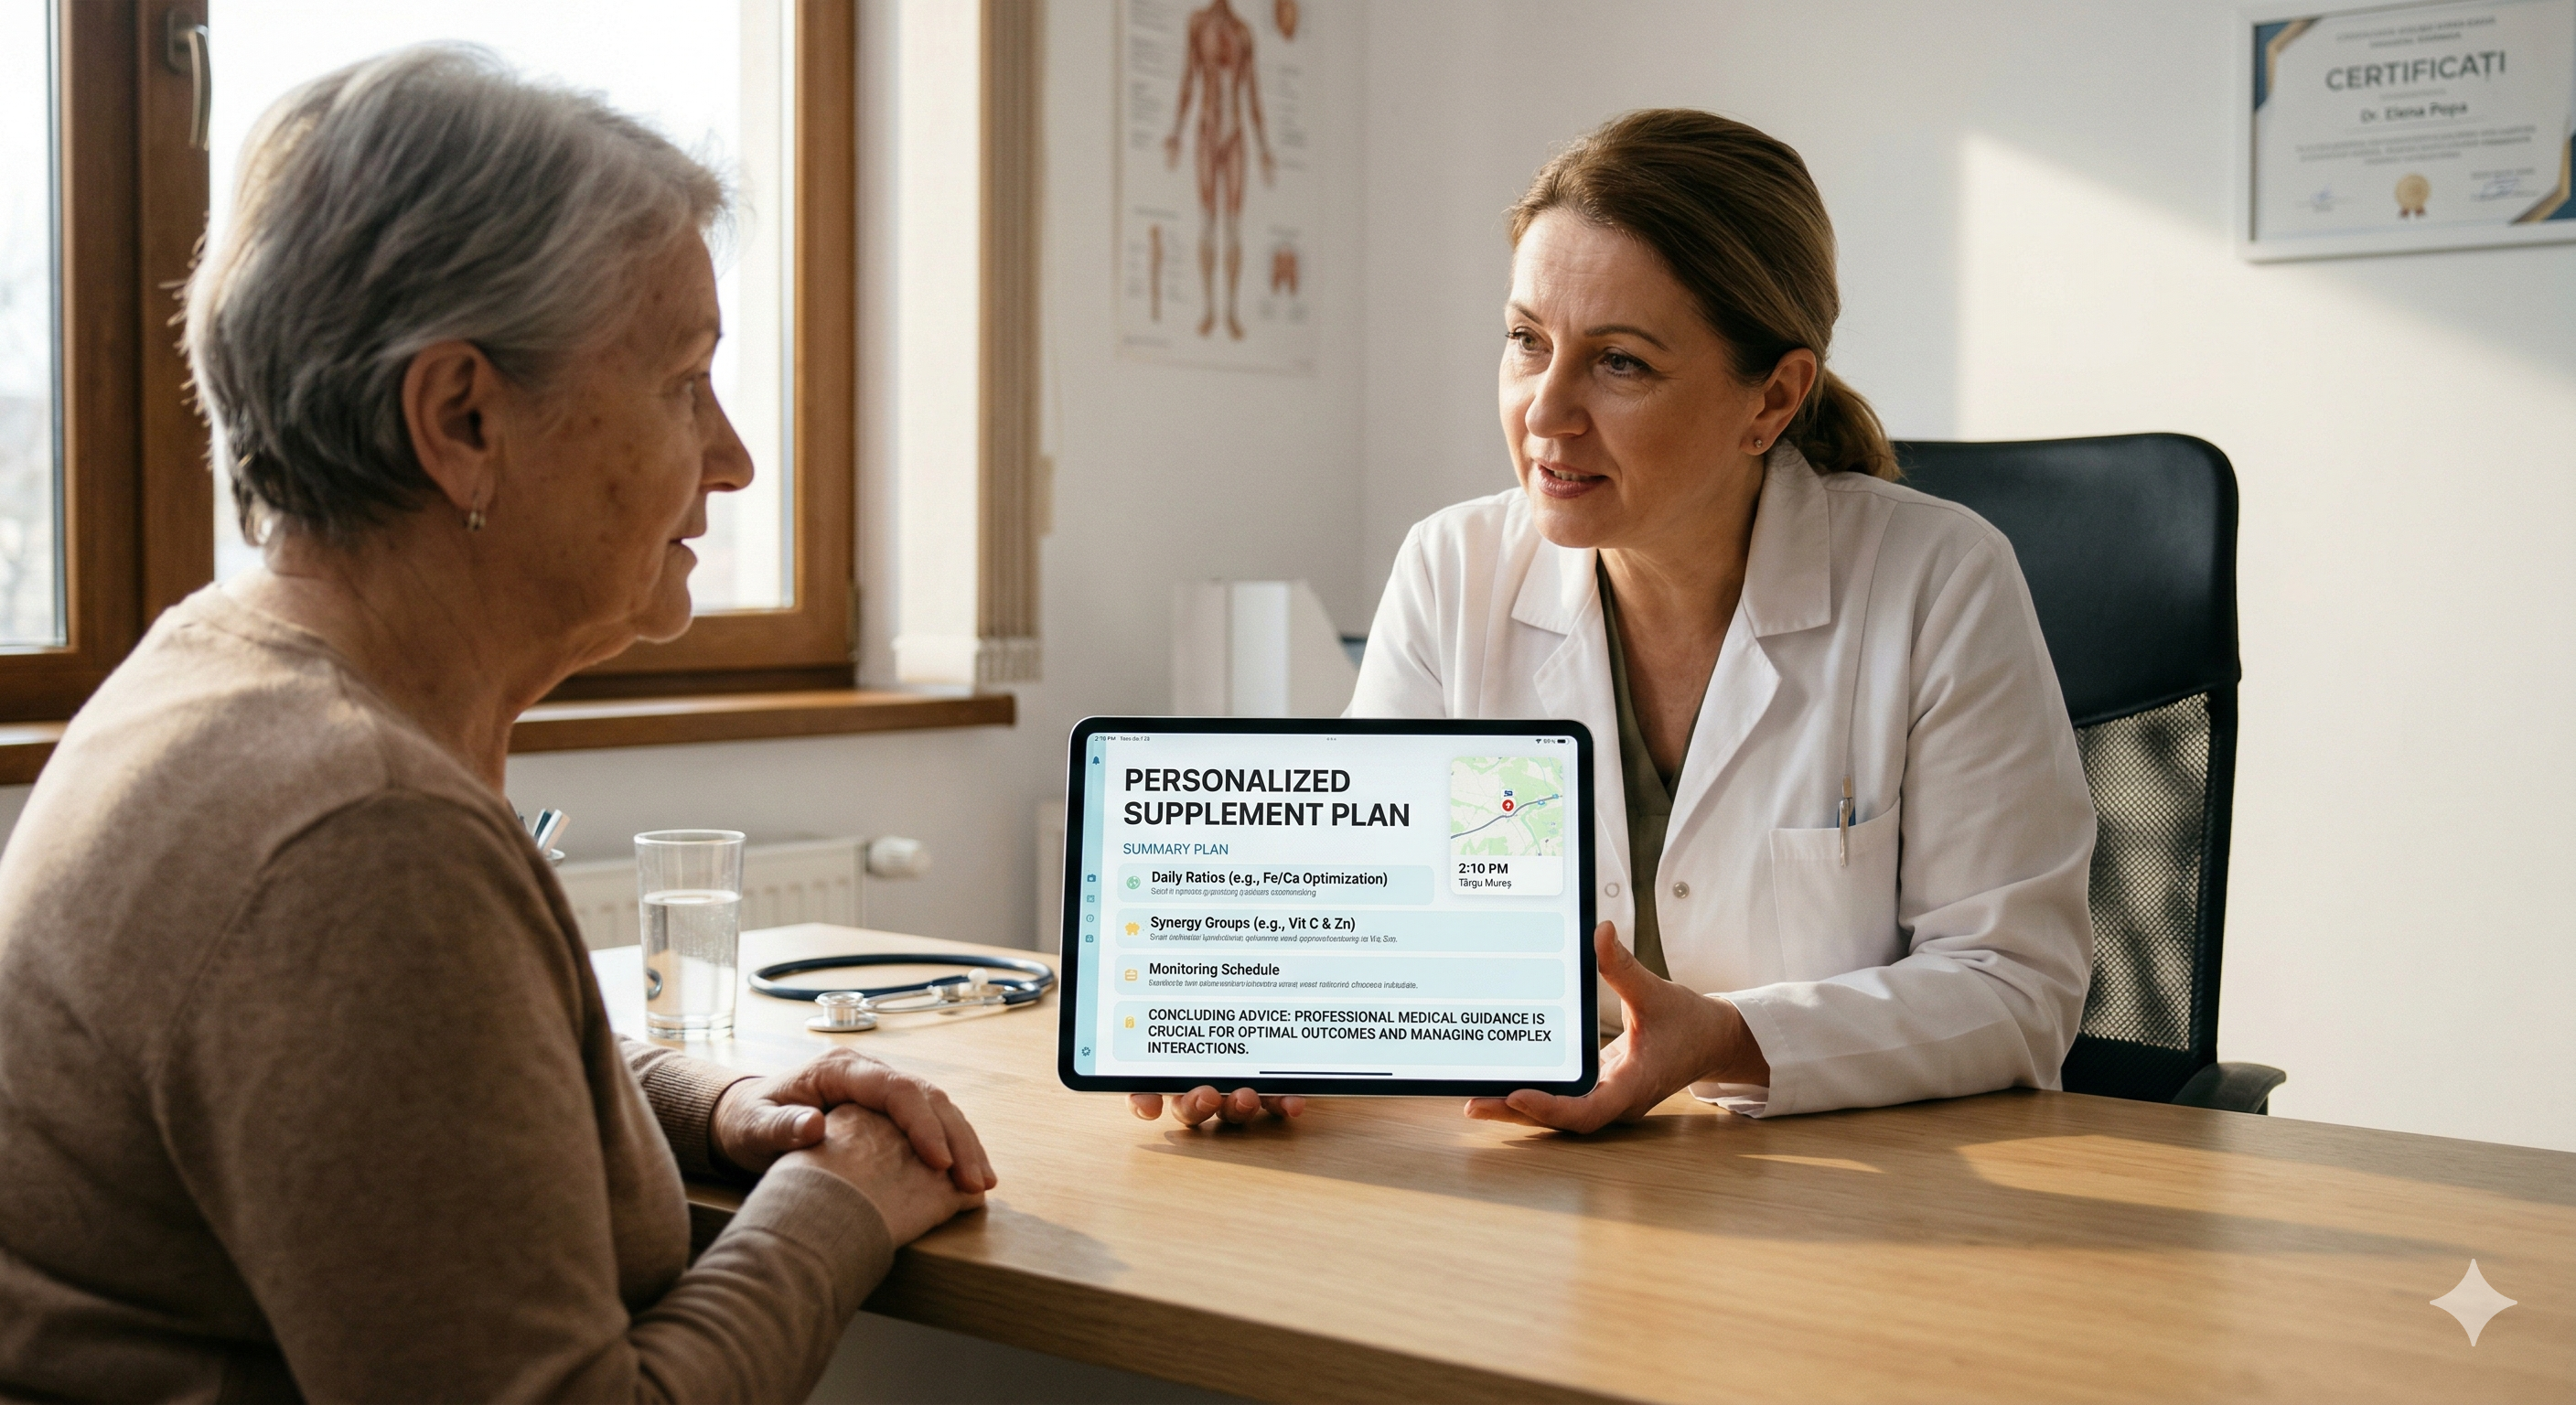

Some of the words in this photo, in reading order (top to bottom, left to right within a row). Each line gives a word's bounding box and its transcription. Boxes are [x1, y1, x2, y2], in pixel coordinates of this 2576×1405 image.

[1125, 767, 1351, 793] PERSONALIZED
[1123, 800, 1324, 826] SUPPLEMENT
[1331, 802, 1410, 827] PLAN
[1122, 842, 1191, 855] SUMMARY
[1194, 843, 1229, 855] PLAN
[1458, 863, 1486, 874] 2:10
[1488, 863, 1508, 874] PM
[1152, 870, 1183, 886] Daily
[1186, 870, 1226, 884] Ratios
[1229, 870, 1260, 887] (e.g.,
[1263, 872, 1300, 885] Fe/Ca
[1303, 872, 1388, 887] Optimization)
[1150, 916, 1203, 932] Synergy
[1205, 916, 1250, 932] Groups
[1253, 916, 1285, 933] (e.g.,
[1288, 917, 1307, 929] Vit
[1309, 917, 1319, 929] C
[1322, 917, 1332, 930] &
[1334, 917, 1356, 933] Zn)
[1149, 962, 1218, 979] Monitoring
[1220, 962, 1280, 976] Schedule
[1148, 1008, 1236, 1022] CONCLUDING
[1238, 1009, 1291, 1022] ADVICE:
[1294, 1010, 1395, 1024] PROFESSIONAL
[1398, 1011, 1458, 1024] MEDICAL
[1460, 1012, 1530, 1024] GUIDANCE
[1532, 1013, 1545, 1025] IS
[1147, 1024, 1206, 1038] CRUCIAL
[1208, 1024, 1236, 1039] FOR
[1238, 1025, 1298, 1040] OPTIMAL
[1301, 1025, 1376, 1040] OUTCOMES
[1378, 1026, 1408, 1041] AND
[1411, 1027, 1485, 1042] MANAGING
[1487, 1028, 1551, 1042] COMPLEX
[1147, 1041, 1250, 1055] INTERACTIONS.
